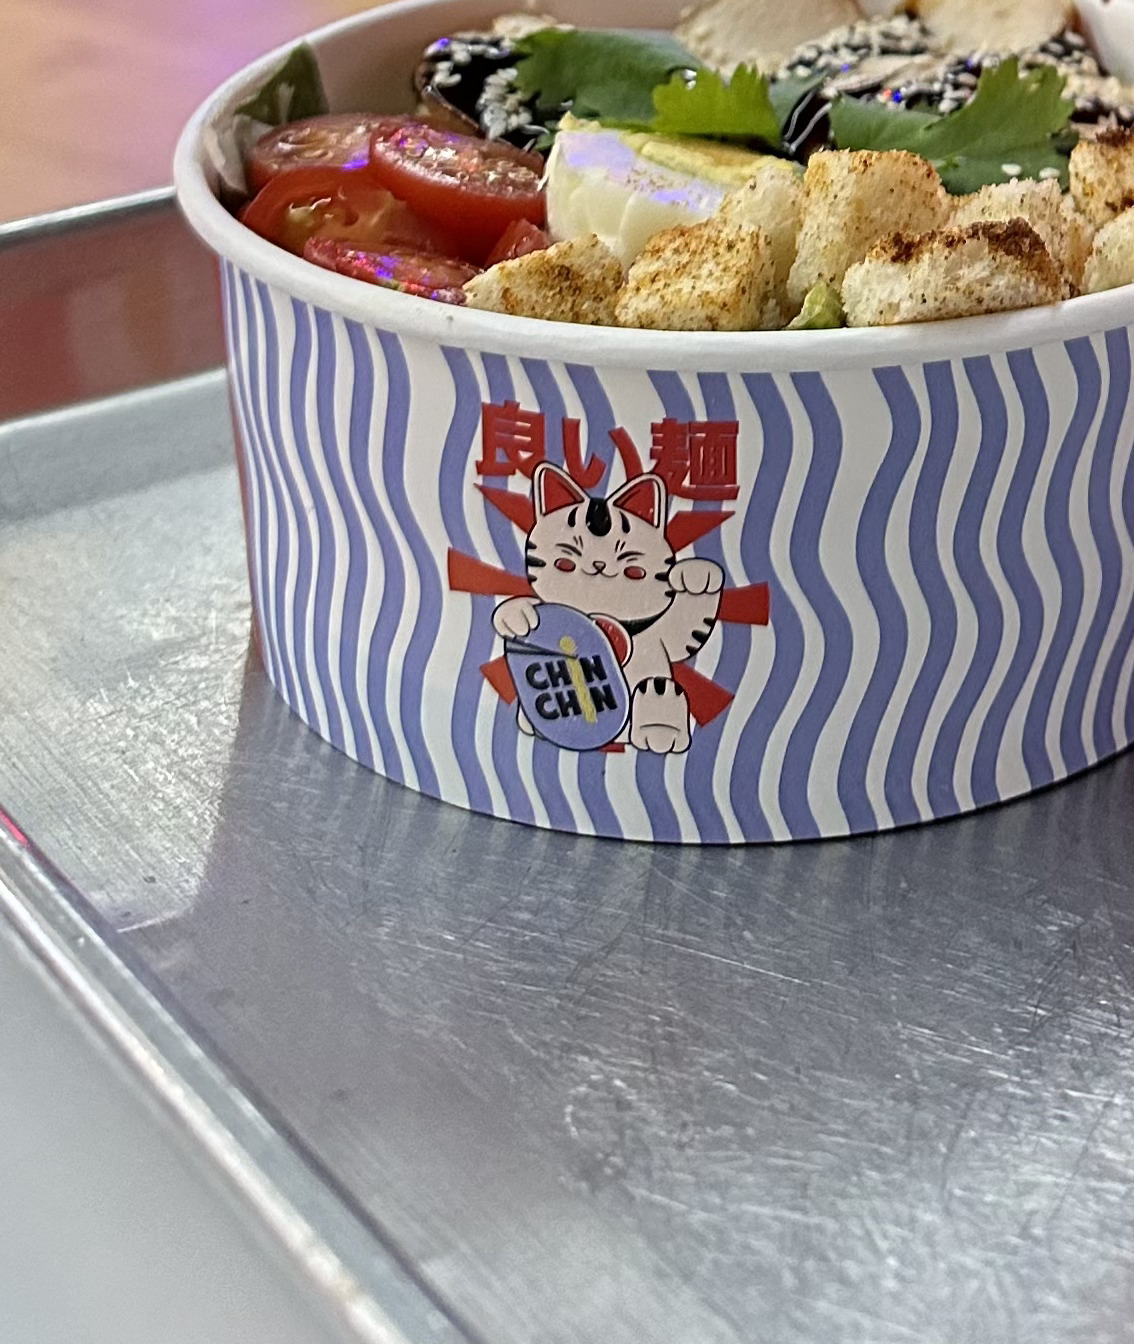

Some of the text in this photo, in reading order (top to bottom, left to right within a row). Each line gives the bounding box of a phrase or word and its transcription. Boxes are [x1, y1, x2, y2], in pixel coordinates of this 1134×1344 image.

[474, 399, 741, 501] 良い麺
[524, 654, 609, 691] CHIN
[534, 684, 618, 722] CHIN
